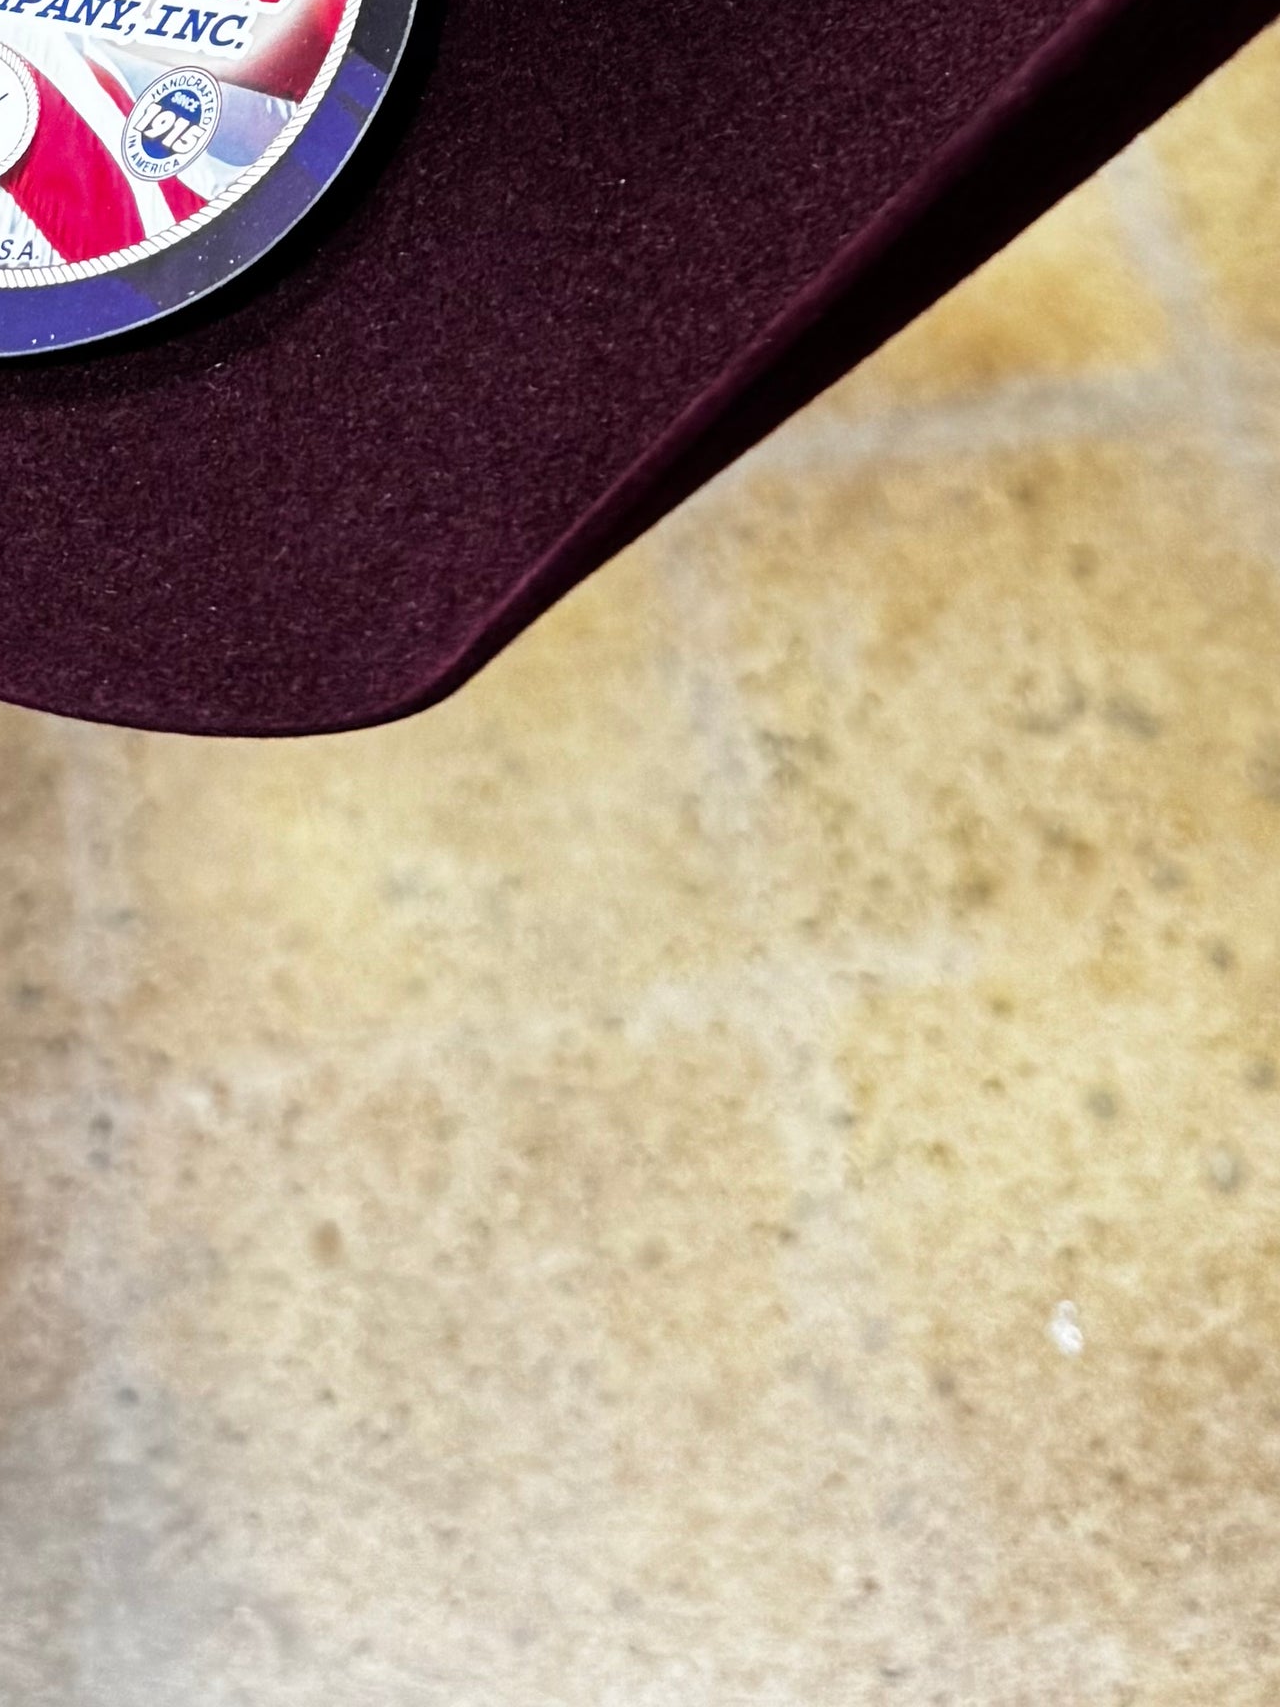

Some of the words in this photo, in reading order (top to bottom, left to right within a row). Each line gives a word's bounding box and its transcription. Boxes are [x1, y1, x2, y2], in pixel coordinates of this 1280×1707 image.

[146, 3, 252, 50] INC.
[151, 74, 214, 126] HANDCRAFTED
[133, 102, 207, 154] 1915
[131, 151, 180, 175] AMERICA
